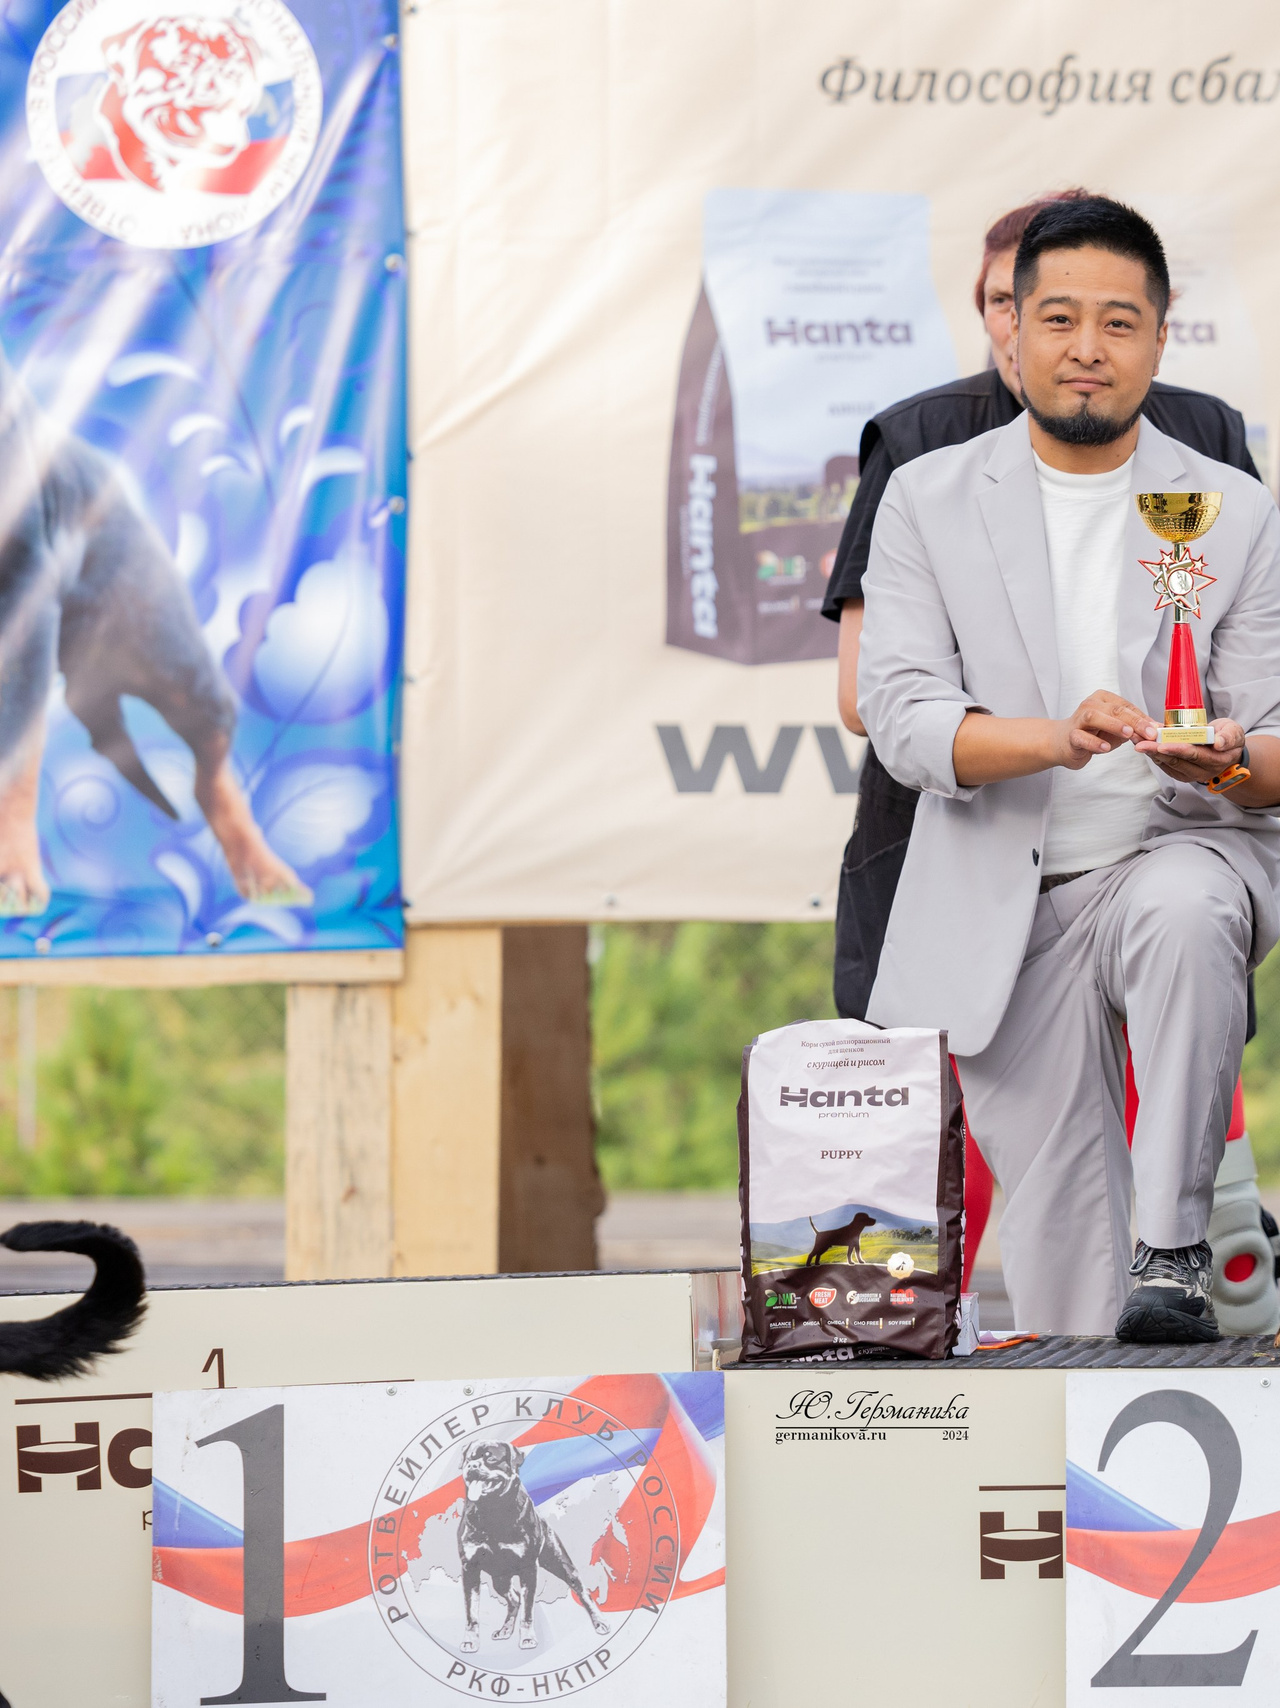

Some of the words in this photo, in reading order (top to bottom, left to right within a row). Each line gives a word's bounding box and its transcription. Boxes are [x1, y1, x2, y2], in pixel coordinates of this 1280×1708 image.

[818, 53, 1154, 117] Философия
[765, 316, 913, 345] Hanta
[688, 453, 720, 639] Hanta
[812, 1058, 849, 1069] курицей
[857, 1059, 885, 1069] рисом
[819, 1040, 835, 1048] сухой
[836, 1038, 891, 1046] полнорационный
[780, 1085, 909, 1108] Hanta
[818, 1111, 870, 1120] premium
[820, 1150, 863, 1159] PUPPY
[202, 1348, 226, 1389] 1
[374, 1403, 490, 1624] РОТВЕЙЛЕР
[515, 1396, 618, 1442] КЛУБ
[626, 1449, 676, 1614] РОССИИ
[195, 1404, 326, 1706] 1
[1090, 1389, 1259, 1688] 2
[447, 1648, 611, 1697] РКФ-НКПР
